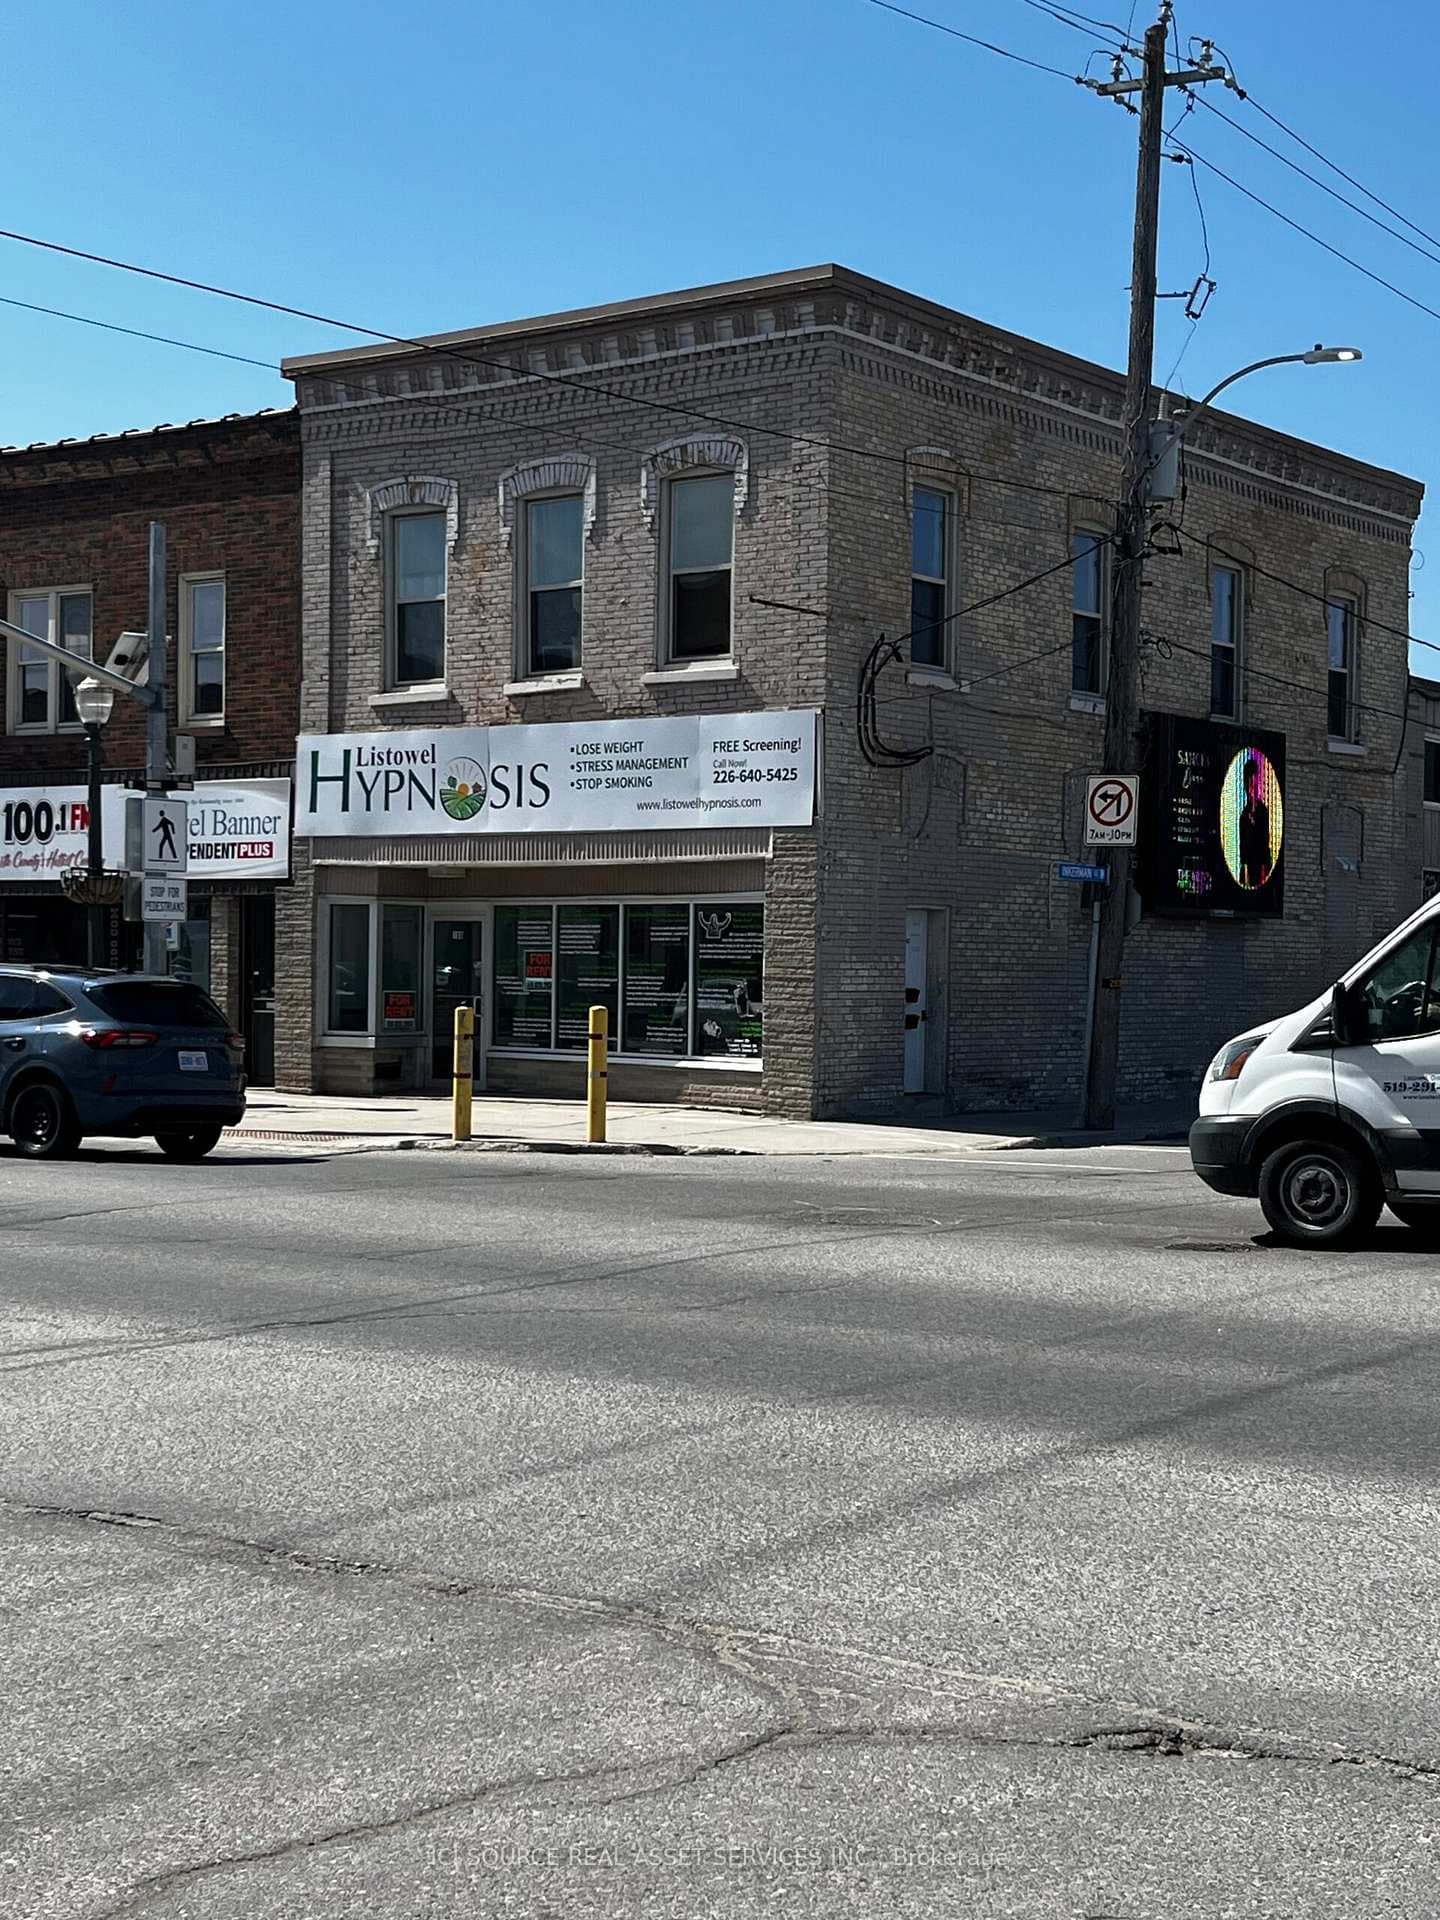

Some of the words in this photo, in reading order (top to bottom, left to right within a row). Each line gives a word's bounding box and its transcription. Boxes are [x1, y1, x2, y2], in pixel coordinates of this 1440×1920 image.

[576, 743, 601, 755] LOSE
[604, 741, 644, 754] WEIGHT
[713, 740, 740, 753] FREE
[743, 737, 801, 753] Screening!
[356, 743, 436, 767] Listowel
[576, 760, 614, 773] STRESS
[616, 757, 688, 771] MANAGEMENT
[713, 759, 727, 769] Call
[728, 759, 747, 769] Now!
[713, 767, 798, 784] 226-640-5425
[576, 778, 603, 790] STOP
[605, 776, 653, 789] SMOKING
[637, 797, 762, 812] www.listowelhypnosis.com
[3, 801, 67, 842] 100.1
[187, 809, 205, 836] el
[212, 809, 281, 836] Banner
[239, 843, 271, 857] PLUS
[150, 887, 166, 898] STOP
[167, 887, 180, 898] FOR
[145, 901, 185, 913] PEDESTRIANS
[529, 953, 551, 966] FOR
